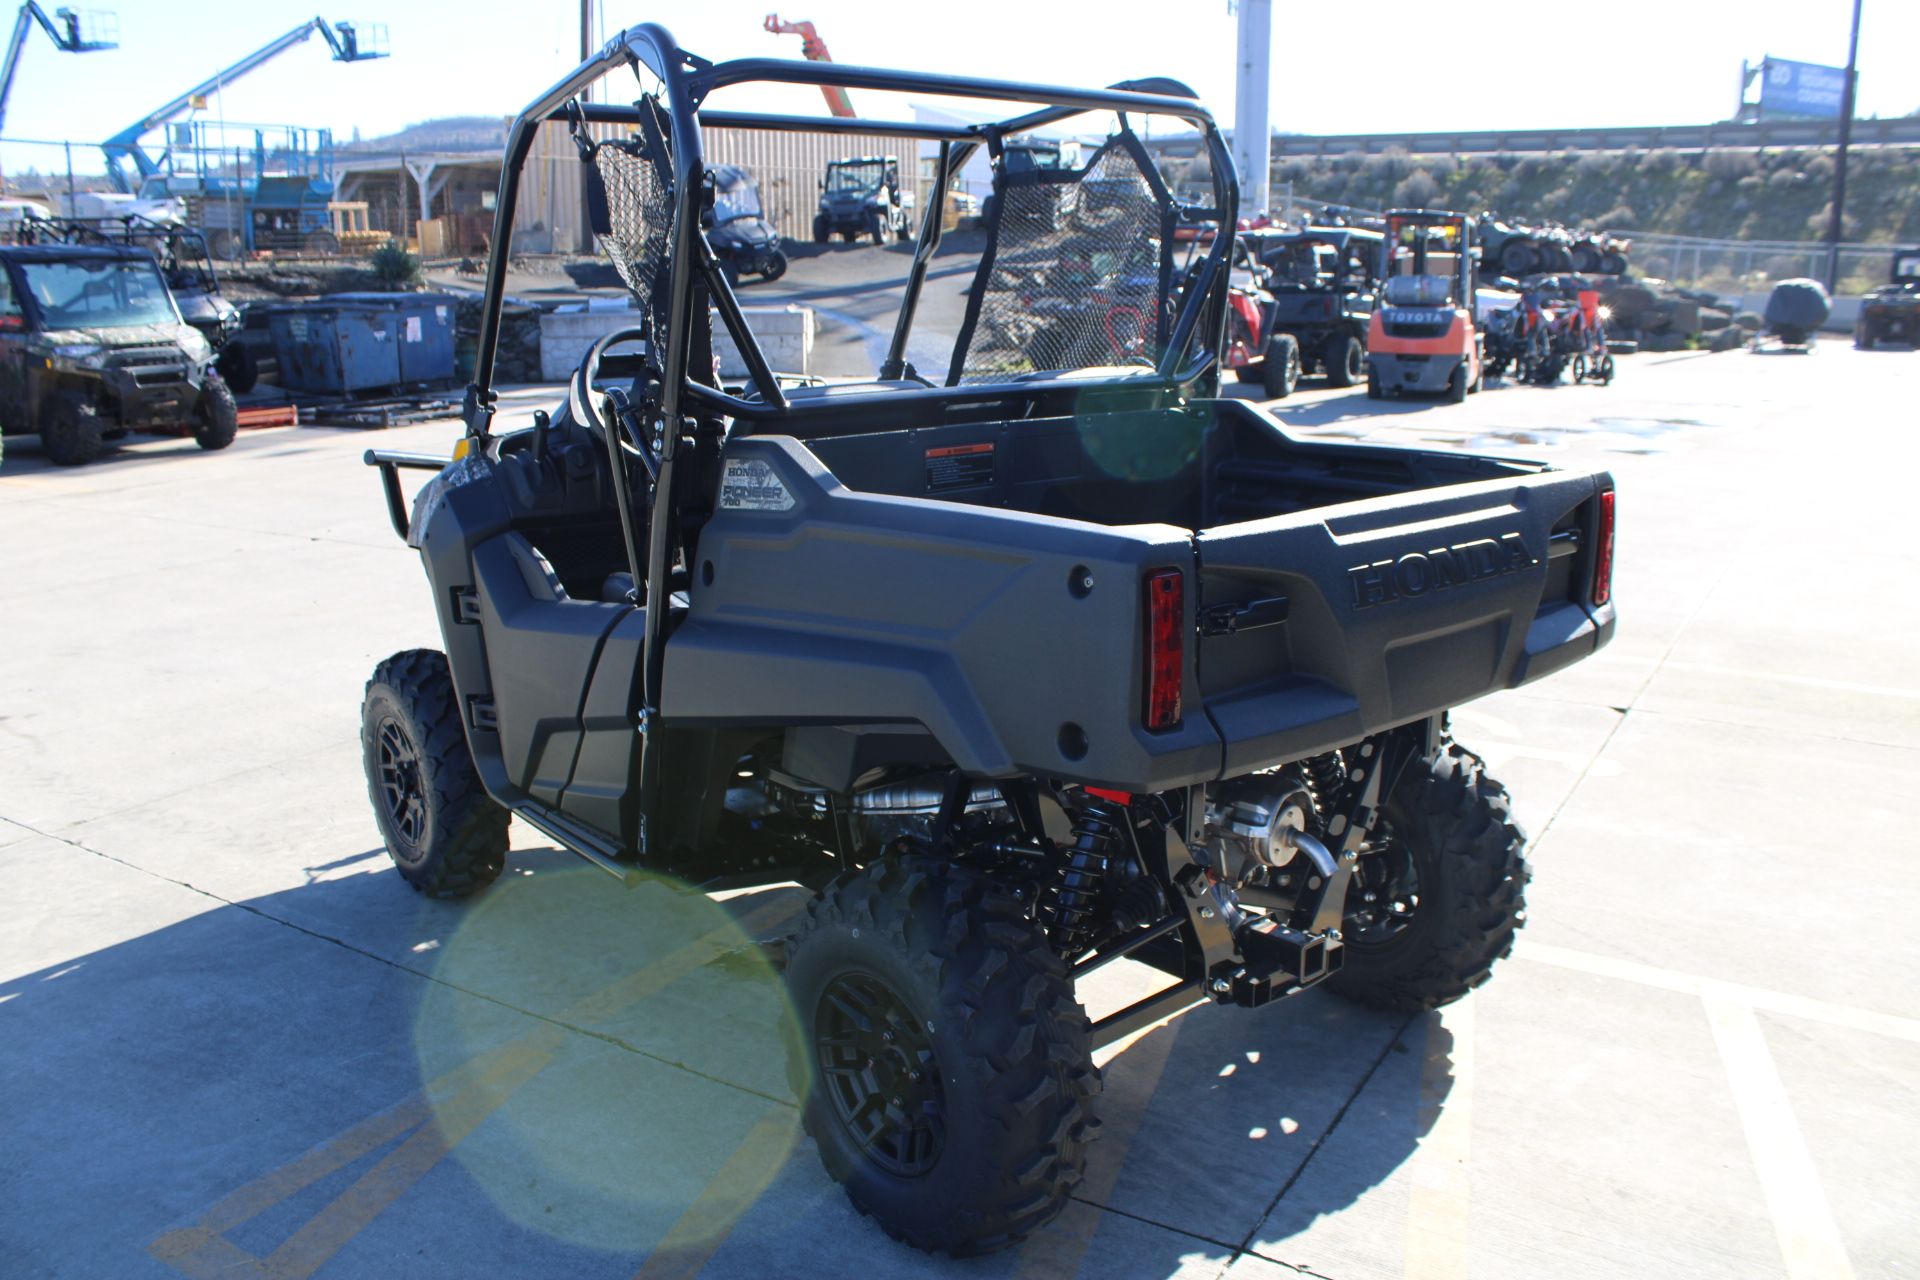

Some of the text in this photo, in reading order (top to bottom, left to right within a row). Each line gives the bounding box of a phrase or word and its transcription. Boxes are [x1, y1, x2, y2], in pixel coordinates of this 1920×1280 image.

[1389, 311, 1443, 323] TOYOTA
[728, 467, 767, 477] HONDA
[723, 485, 782, 499] PIONEER
[1348, 532, 1538, 611] HONDA
